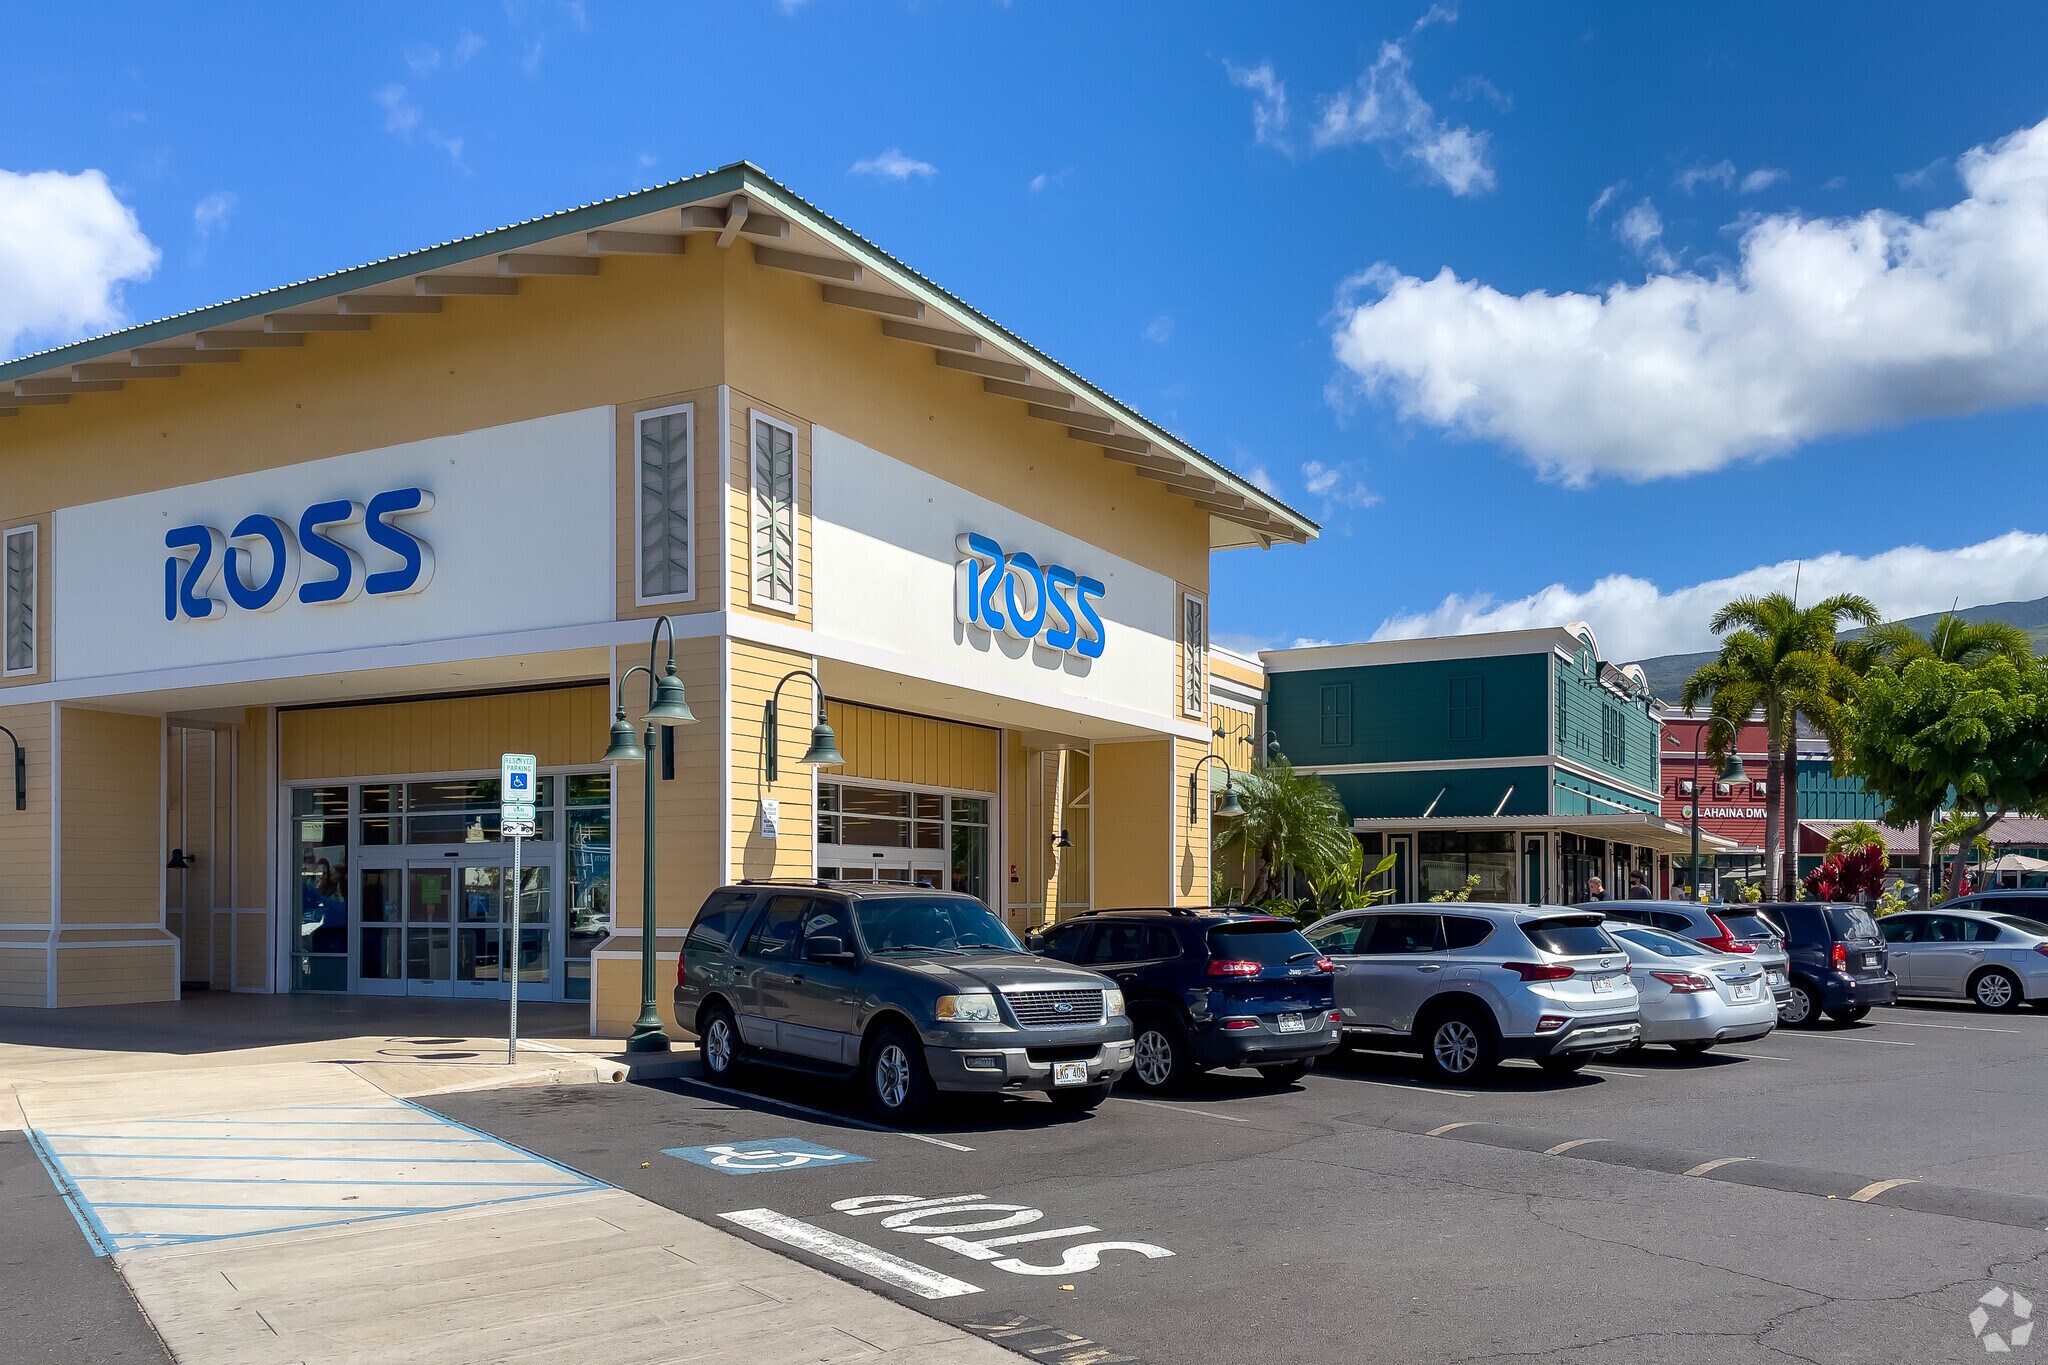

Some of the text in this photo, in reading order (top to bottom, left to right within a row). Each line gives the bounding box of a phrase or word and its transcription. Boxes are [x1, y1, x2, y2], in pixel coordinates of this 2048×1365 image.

[165, 487, 422, 621] ROSS
[968, 531, 1106, 659] ROSS
[505, 757, 534, 765] RESERVED
[506, 764, 532, 772] PARKING
[1697, 808, 1743, 818] LAHAINA
[831, 1194, 1176, 1276] STOP
